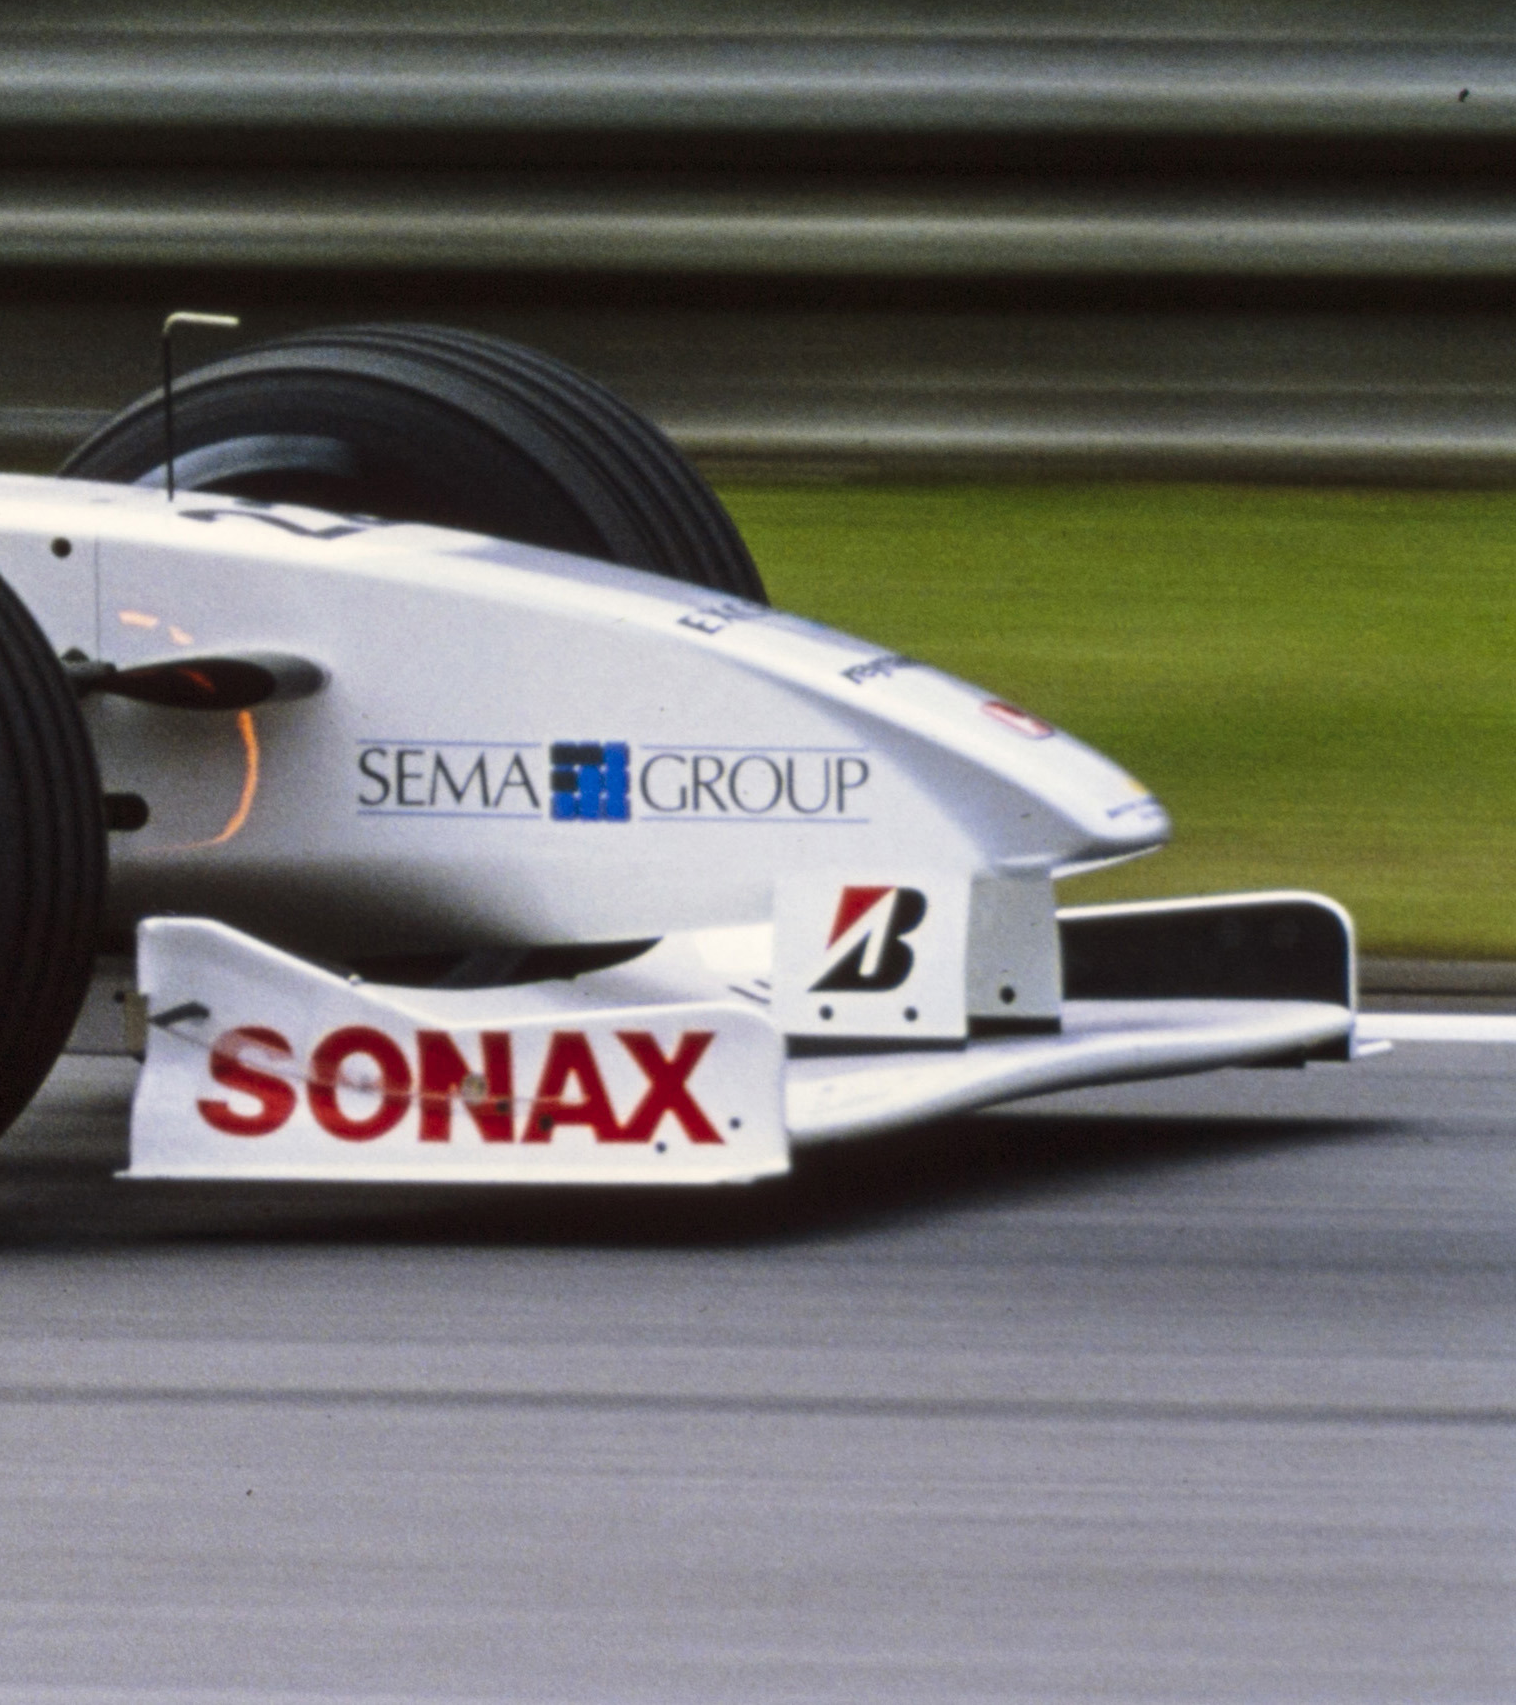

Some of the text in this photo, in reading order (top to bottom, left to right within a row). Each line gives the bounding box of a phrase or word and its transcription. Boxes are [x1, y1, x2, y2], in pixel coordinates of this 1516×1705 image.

[356, 746, 871, 816] SEMA GROUP
[196, 1024, 727, 1144] SONAX
